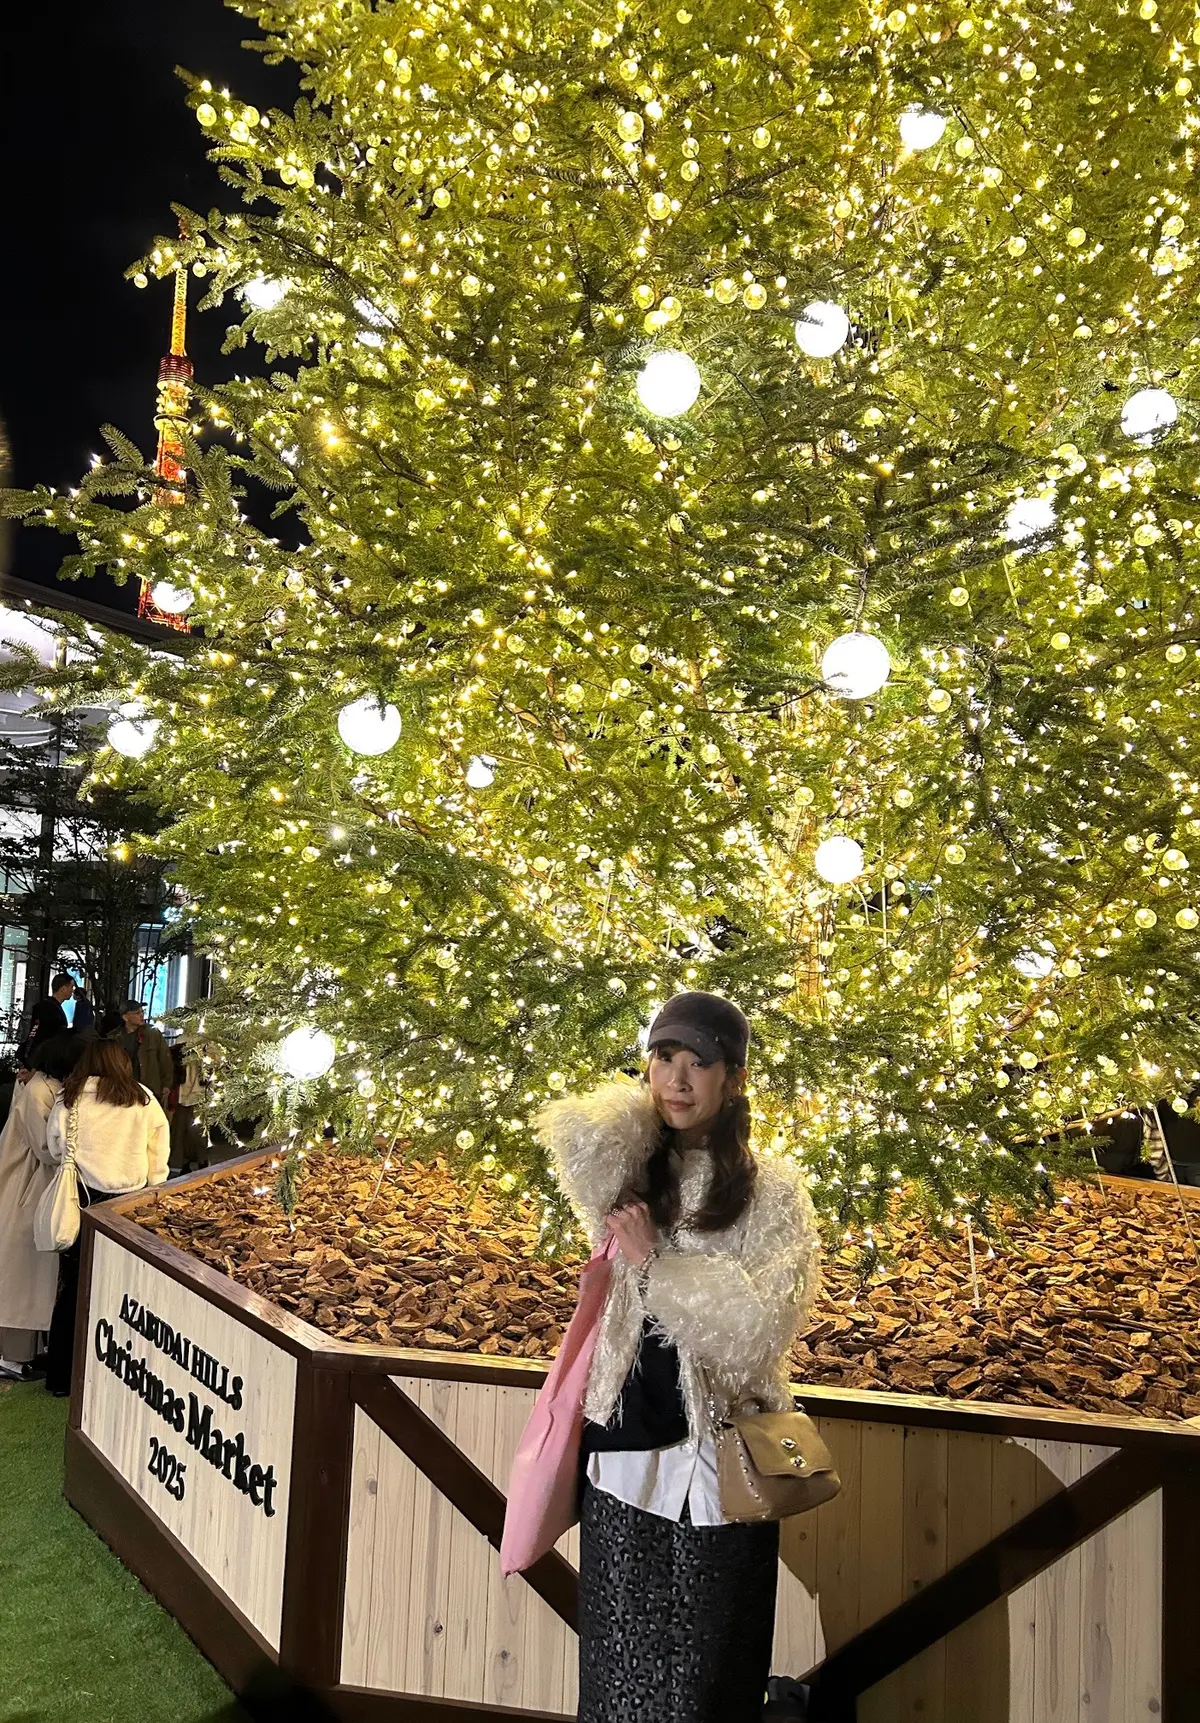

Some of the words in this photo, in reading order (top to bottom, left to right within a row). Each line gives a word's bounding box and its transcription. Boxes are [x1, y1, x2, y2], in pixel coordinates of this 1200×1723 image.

[119, 1293, 190, 1371] AZABUDAI
[190, 1345, 244, 1411] HILLS
[95, 1318, 186, 1433] Christmas
[185, 1391, 277, 1518] Market
[147, 1436, 187, 1501] 2025
